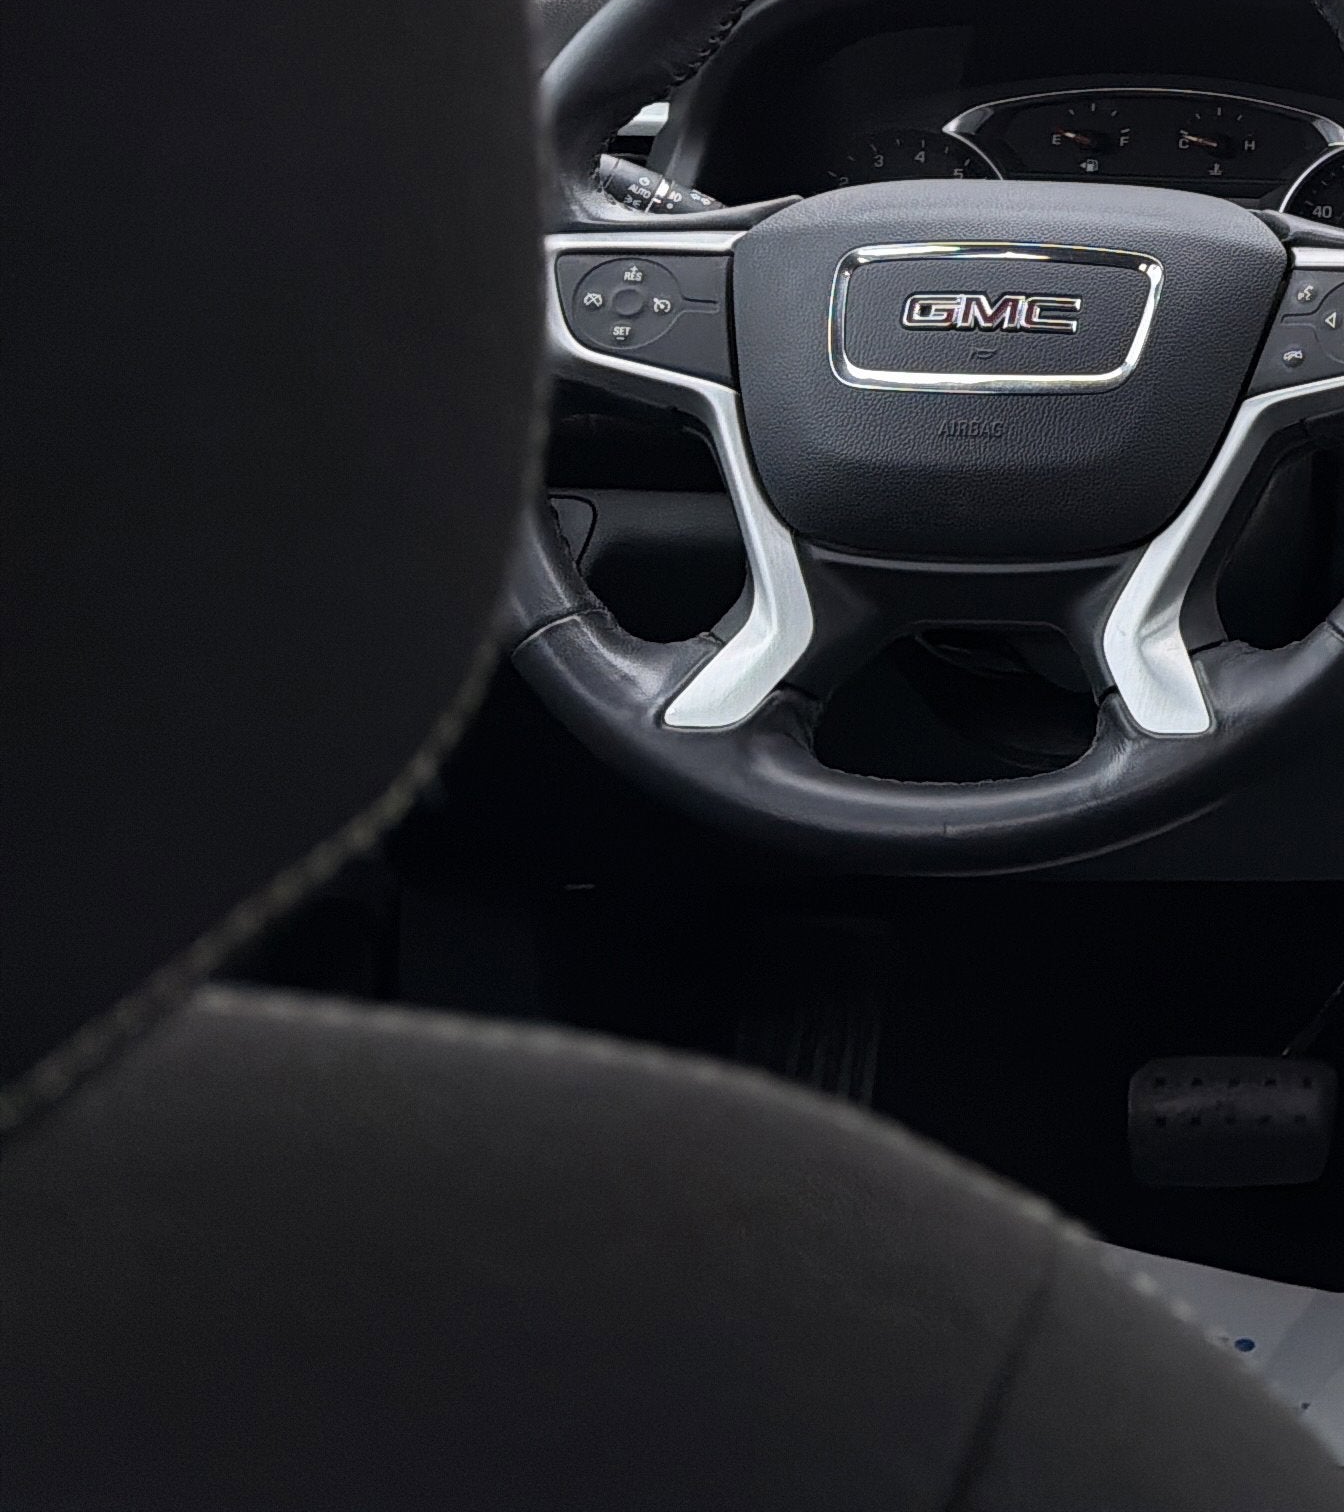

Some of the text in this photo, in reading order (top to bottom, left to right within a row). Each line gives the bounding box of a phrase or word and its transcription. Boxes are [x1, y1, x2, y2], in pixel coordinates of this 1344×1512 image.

[1053, 135, 1061, 145] E
[1120, 137, 1128, 146] F
[1245, 140, 1255, 150] H
[874, 155, 884, 168] 3
[914, 150, 925, 163] 4
[628, 184, 651, 199] AUTO
[1312, 205, 1332, 219] 40
[624, 271, 643, 282] RES
[902, 292, 1083, 333] GMC
[613, 326, 631, 336] SET
[938, 419, 1003, 437] AIRBAG
